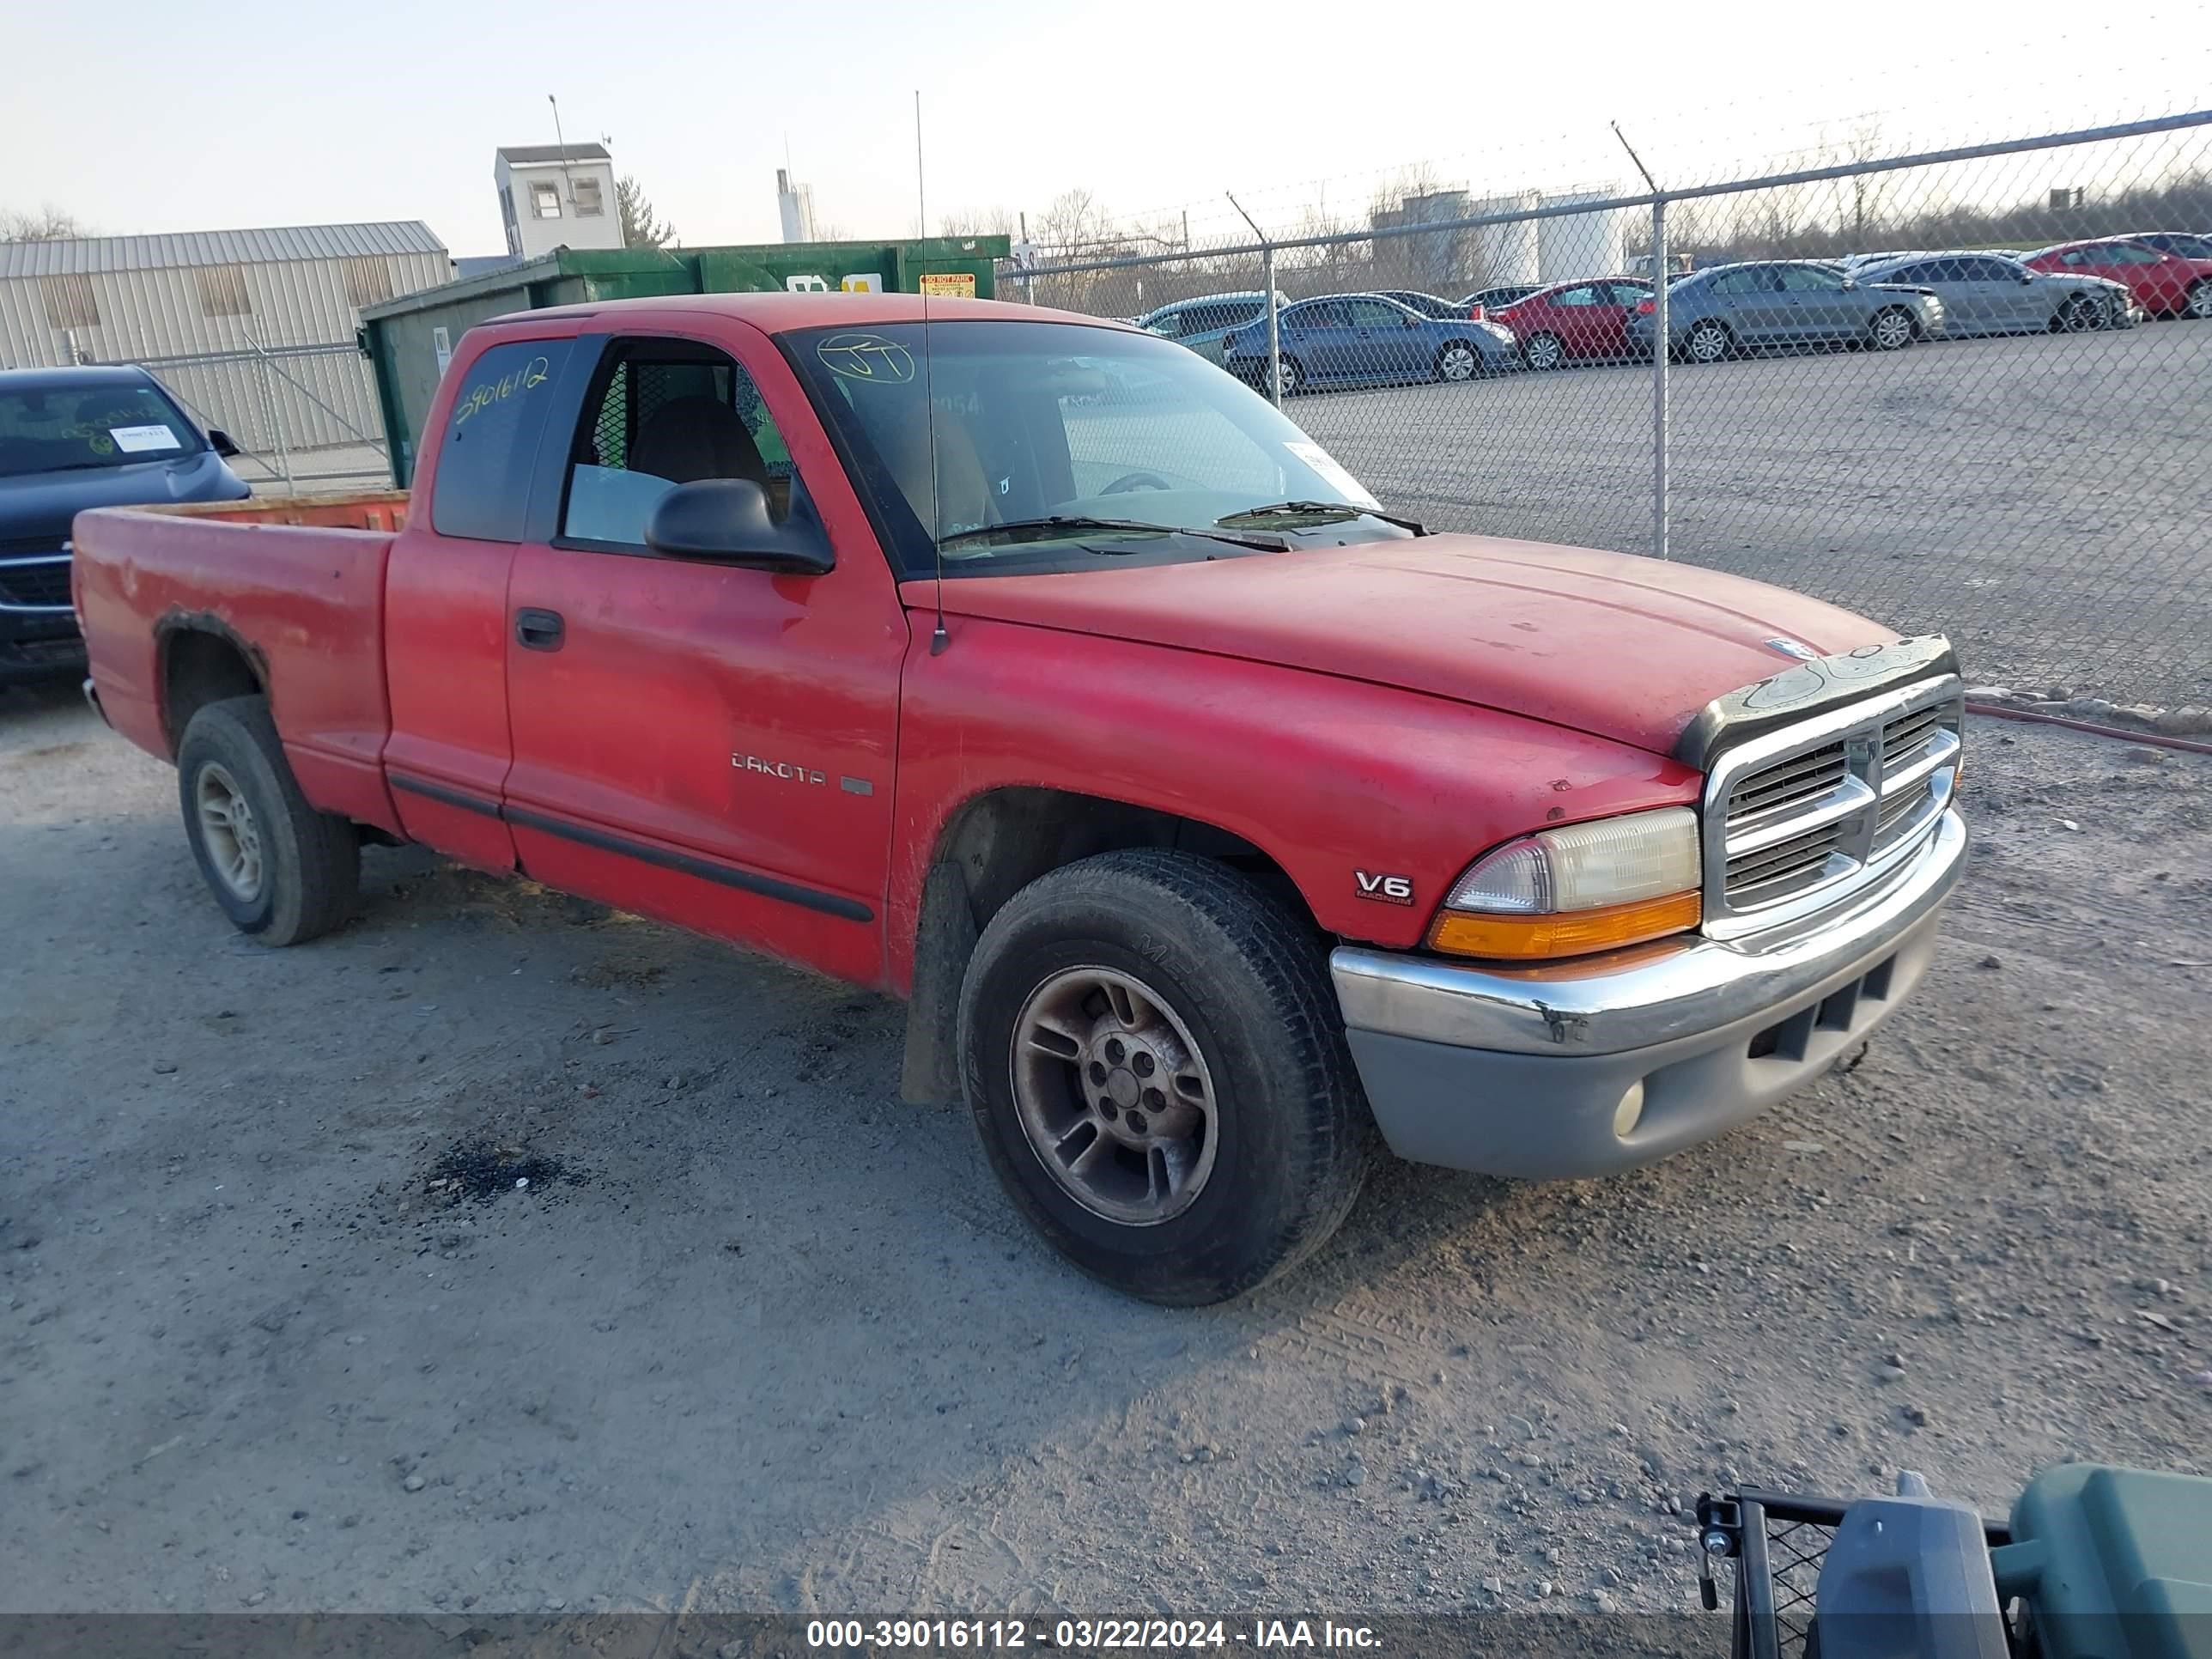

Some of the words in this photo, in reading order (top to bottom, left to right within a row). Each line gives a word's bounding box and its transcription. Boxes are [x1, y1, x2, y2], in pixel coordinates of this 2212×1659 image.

[952, 275, 969, 283] PARK
[732, 752, 826, 785] DAKOTA
[1355, 871, 1410, 898] V6
[1356, 890, 1413, 906] MAGNUM
